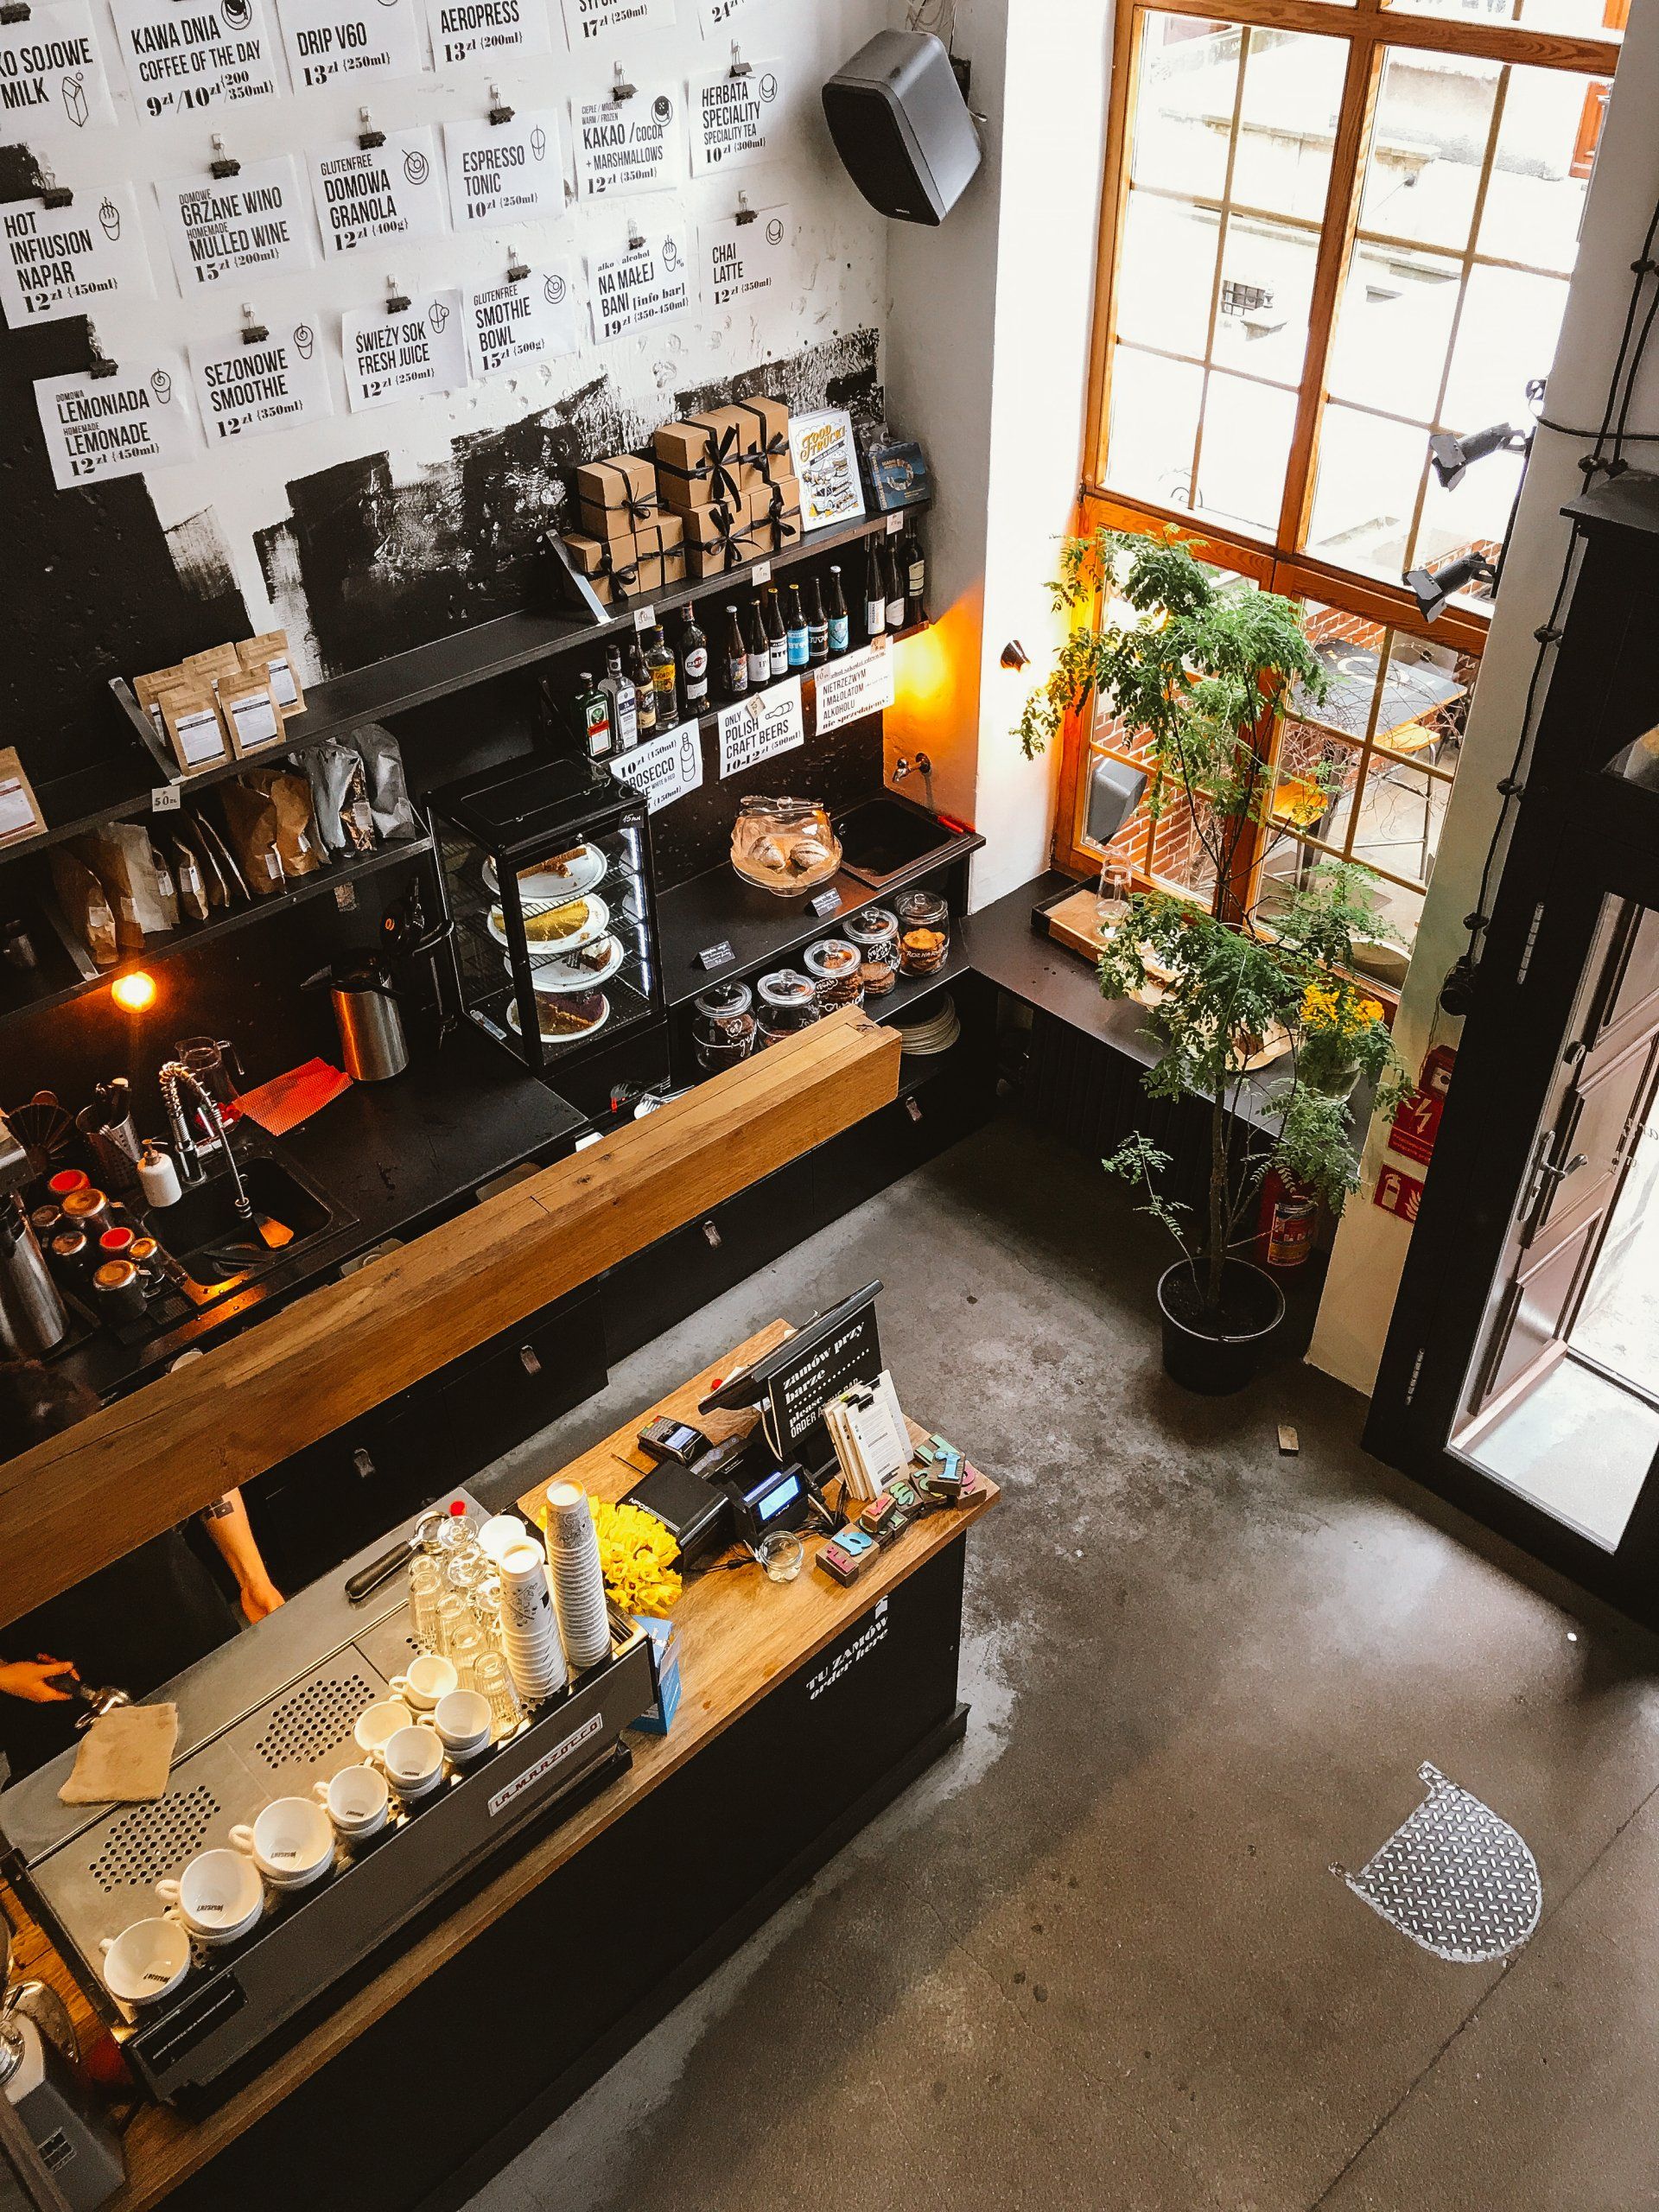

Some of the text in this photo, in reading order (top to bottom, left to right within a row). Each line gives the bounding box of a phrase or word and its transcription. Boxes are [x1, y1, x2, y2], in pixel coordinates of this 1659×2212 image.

[441, 0, 519, 34] AEROPRESS
[130, 15, 221, 54] KAWA DNIA
[296, 22, 367, 56] DRIP V60
[20, 37, 93, 73] SOJOWE
[139, 40, 261, 82] COFFEE OF THE DAY
[0, 76, 49, 109] MILK
[702, 80, 748, 107] HERBATA
[582, 112, 619, 125] WARM FROZEN
[702, 100, 760, 130] SPECIALITY
[583, 123, 626, 149] KAKAO
[703, 123, 757, 145] SPECIALITY TEA
[321, 154, 373, 176] GLUTENFREE
[462, 145, 525, 173] ESPRESSO
[594, 145, 663, 170] MARSHMALLOWS
[179, 188, 213, 206] DOMOWE
[324, 169, 391, 203] DOMOWA
[463, 173, 501, 197] TONIC
[181, 186, 283, 227] GRZANE WINO
[329, 194, 397, 230] GRANOLA
[3, 211, 37, 238] HOT
[186, 221, 229, 240] HOMEMADE
[188, 220, 290, 261] MULLED WINE
[9, 229, 93, 265] INFIUSION
[597, 250, 650, 271] alko alcohol
[712, 243, 736, 264] CHAI
[16, 260, 76, 292] NAPAR
[598, 262, 654, 296] NA MAŁEJ
[713, 261, 744, 284] LATTE
[474, 283, 518, 306] GLUTENFREE
[601, 292, 630, 317] BANI
[474, 296, 531, 329] SMOTHIE
[355, 321, 427, 353] ŚWIEŻY SOK
[479, 326, 516, 352] BOWL
[204, 348, 289, 388] SEZONOWE
[358, 343, 430, 376] FRESH JUICE
[55, 390, 85, 403] DOMOWA
[57, 388, 150, 424] LEMONIADA
[210, 374, 289, 412] SMOOTHIE
[63, 422, 100, 436] HOMEMADE
[65, 422, 151, 457] LEMONADE
[725, 710, 742, 728] ONLY
[823, 699, 855, 721] ALKOHOLU
[726, 717, 760, 745] POLISH
[726, 719, 789, 760] CRAFT BEERS
[783, 1321, 865, 1390] zamów przy
[785, 1369, 826, 1405] barze
[789, 1395, 823, 1428] please
[790, 1410, 817, 1439] ORDER
[806, 1616, 888, 1690] TU ZAMÓW
[810, 1629, 888, 1700] order here
